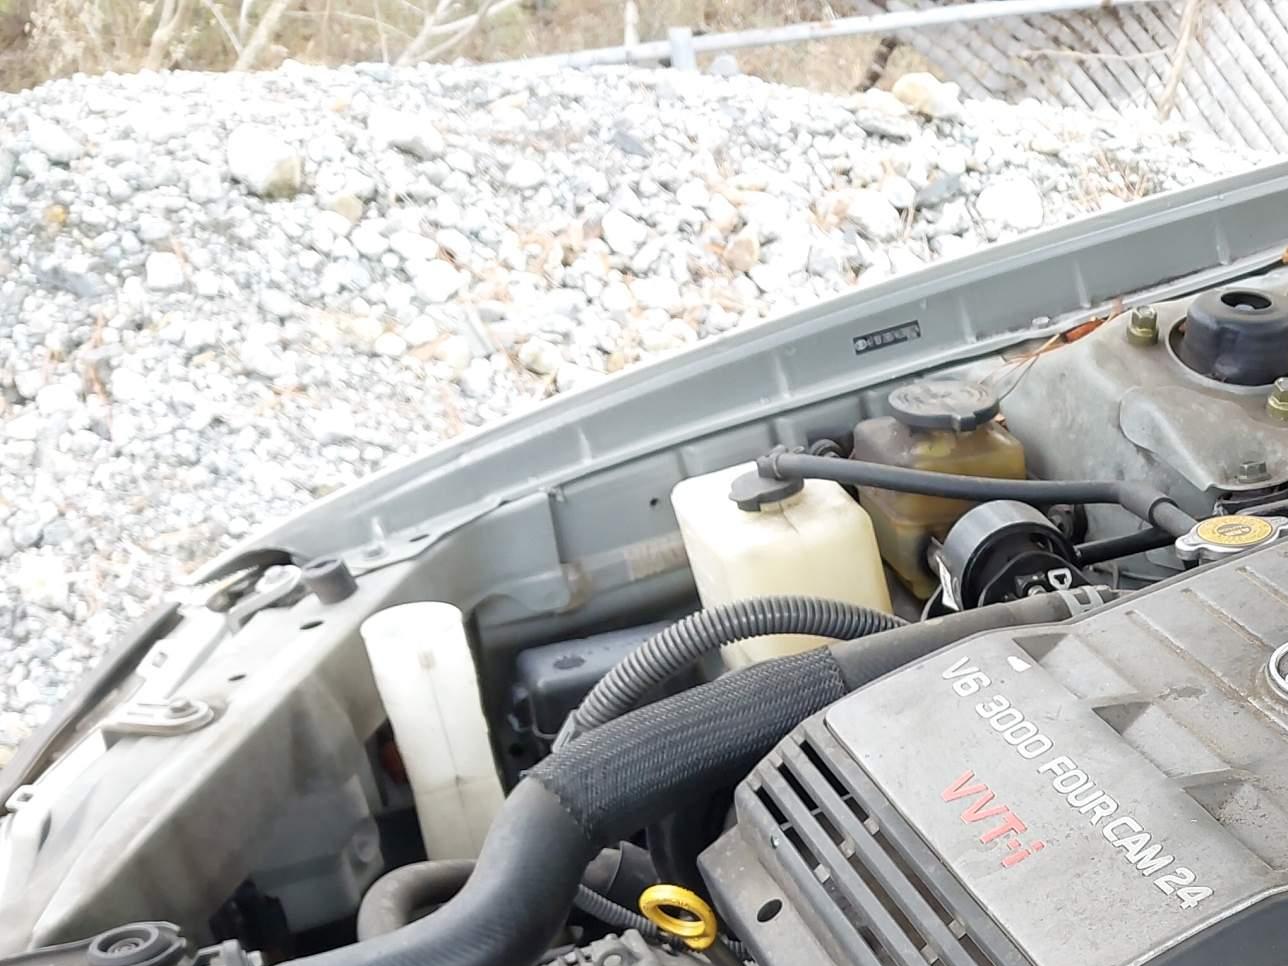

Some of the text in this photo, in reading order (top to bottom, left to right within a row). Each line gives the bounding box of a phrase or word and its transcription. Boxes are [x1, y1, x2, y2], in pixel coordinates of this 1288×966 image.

[941, 656, 1214, 910] V6 3000 FOUR CAM 24
[941, 769, 1046, 868] VVT-i
